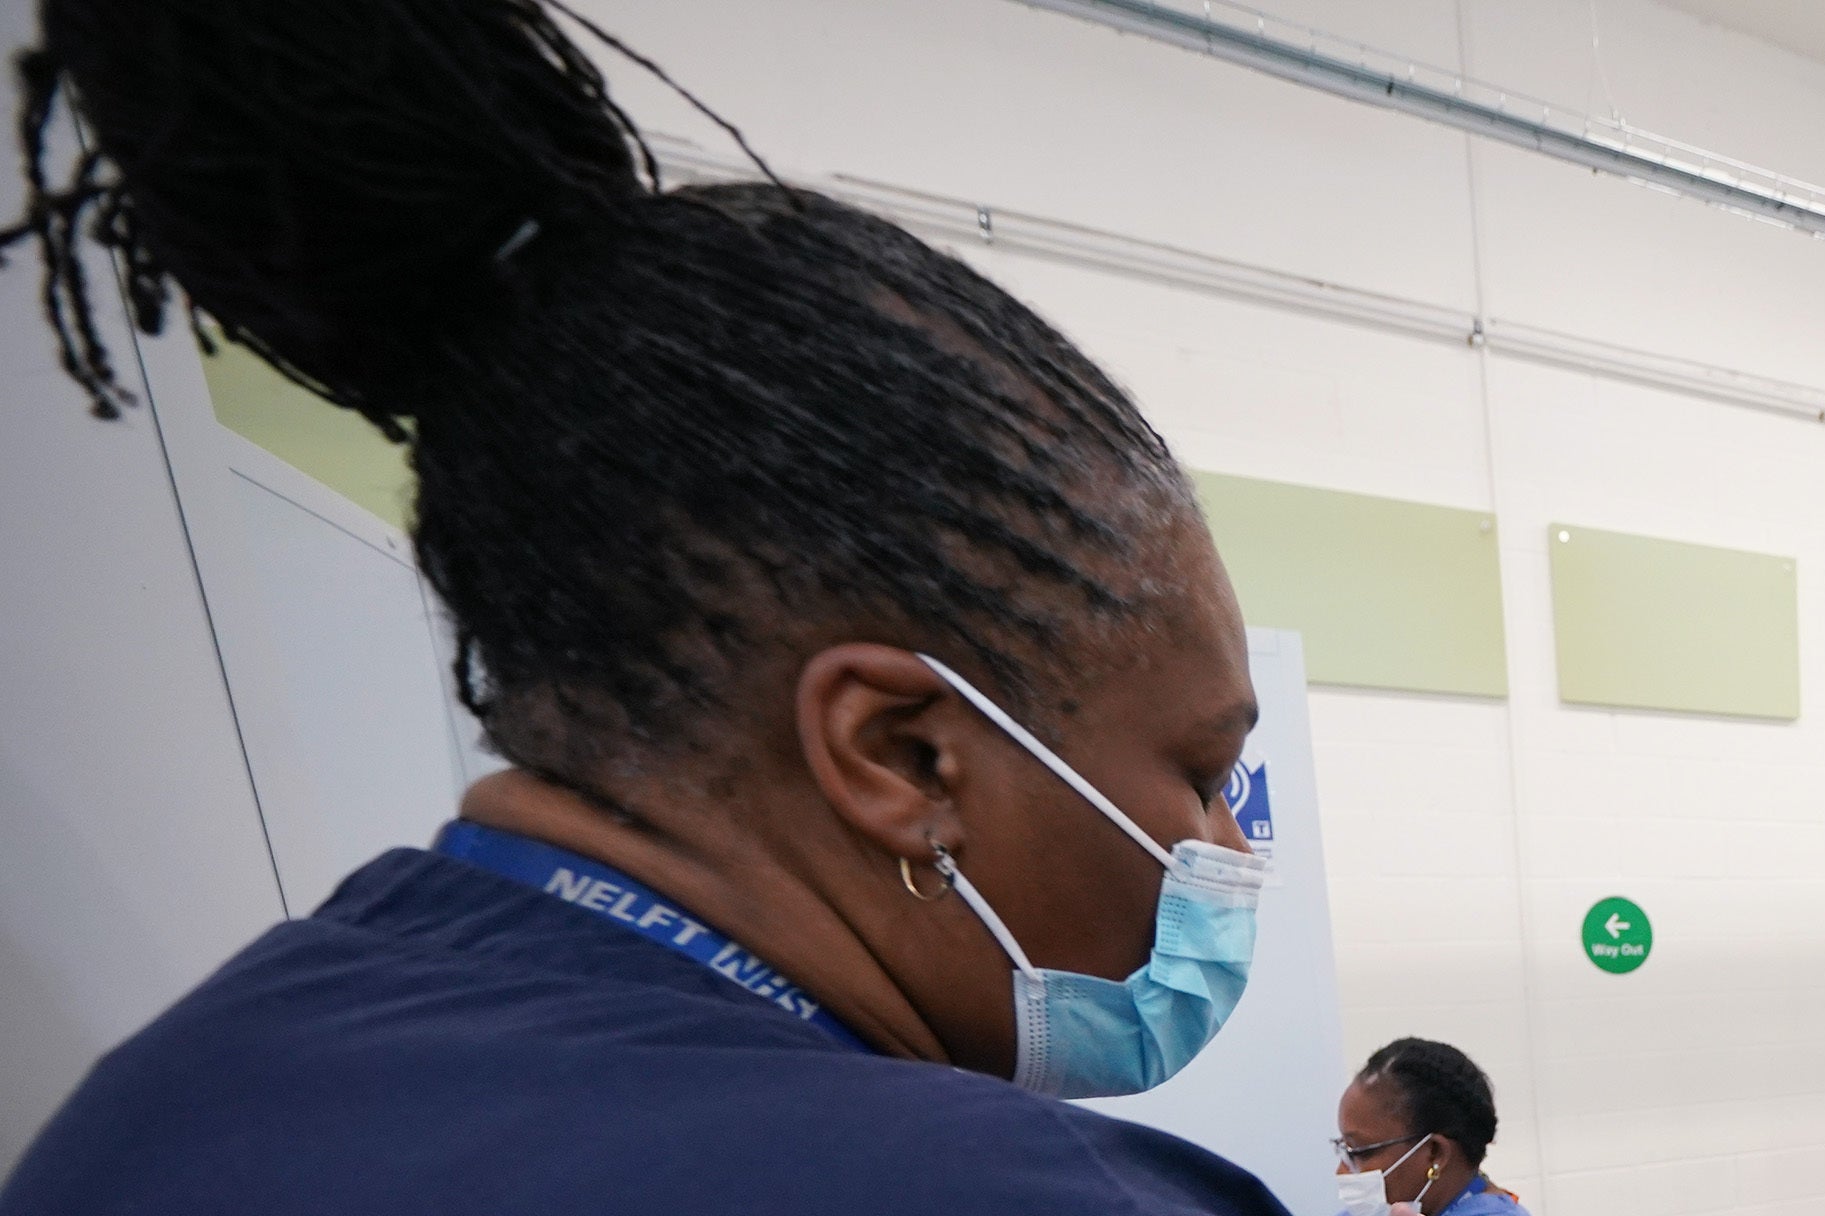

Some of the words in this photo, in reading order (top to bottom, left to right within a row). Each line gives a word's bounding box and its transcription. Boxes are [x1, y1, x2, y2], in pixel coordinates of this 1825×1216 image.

[544, 867, 711, 946] NELFT
[711, 943, 819, 1021] NHS
[1591, 943, 1619, 958] Way
[1620, 942, 1643, 956] Out
